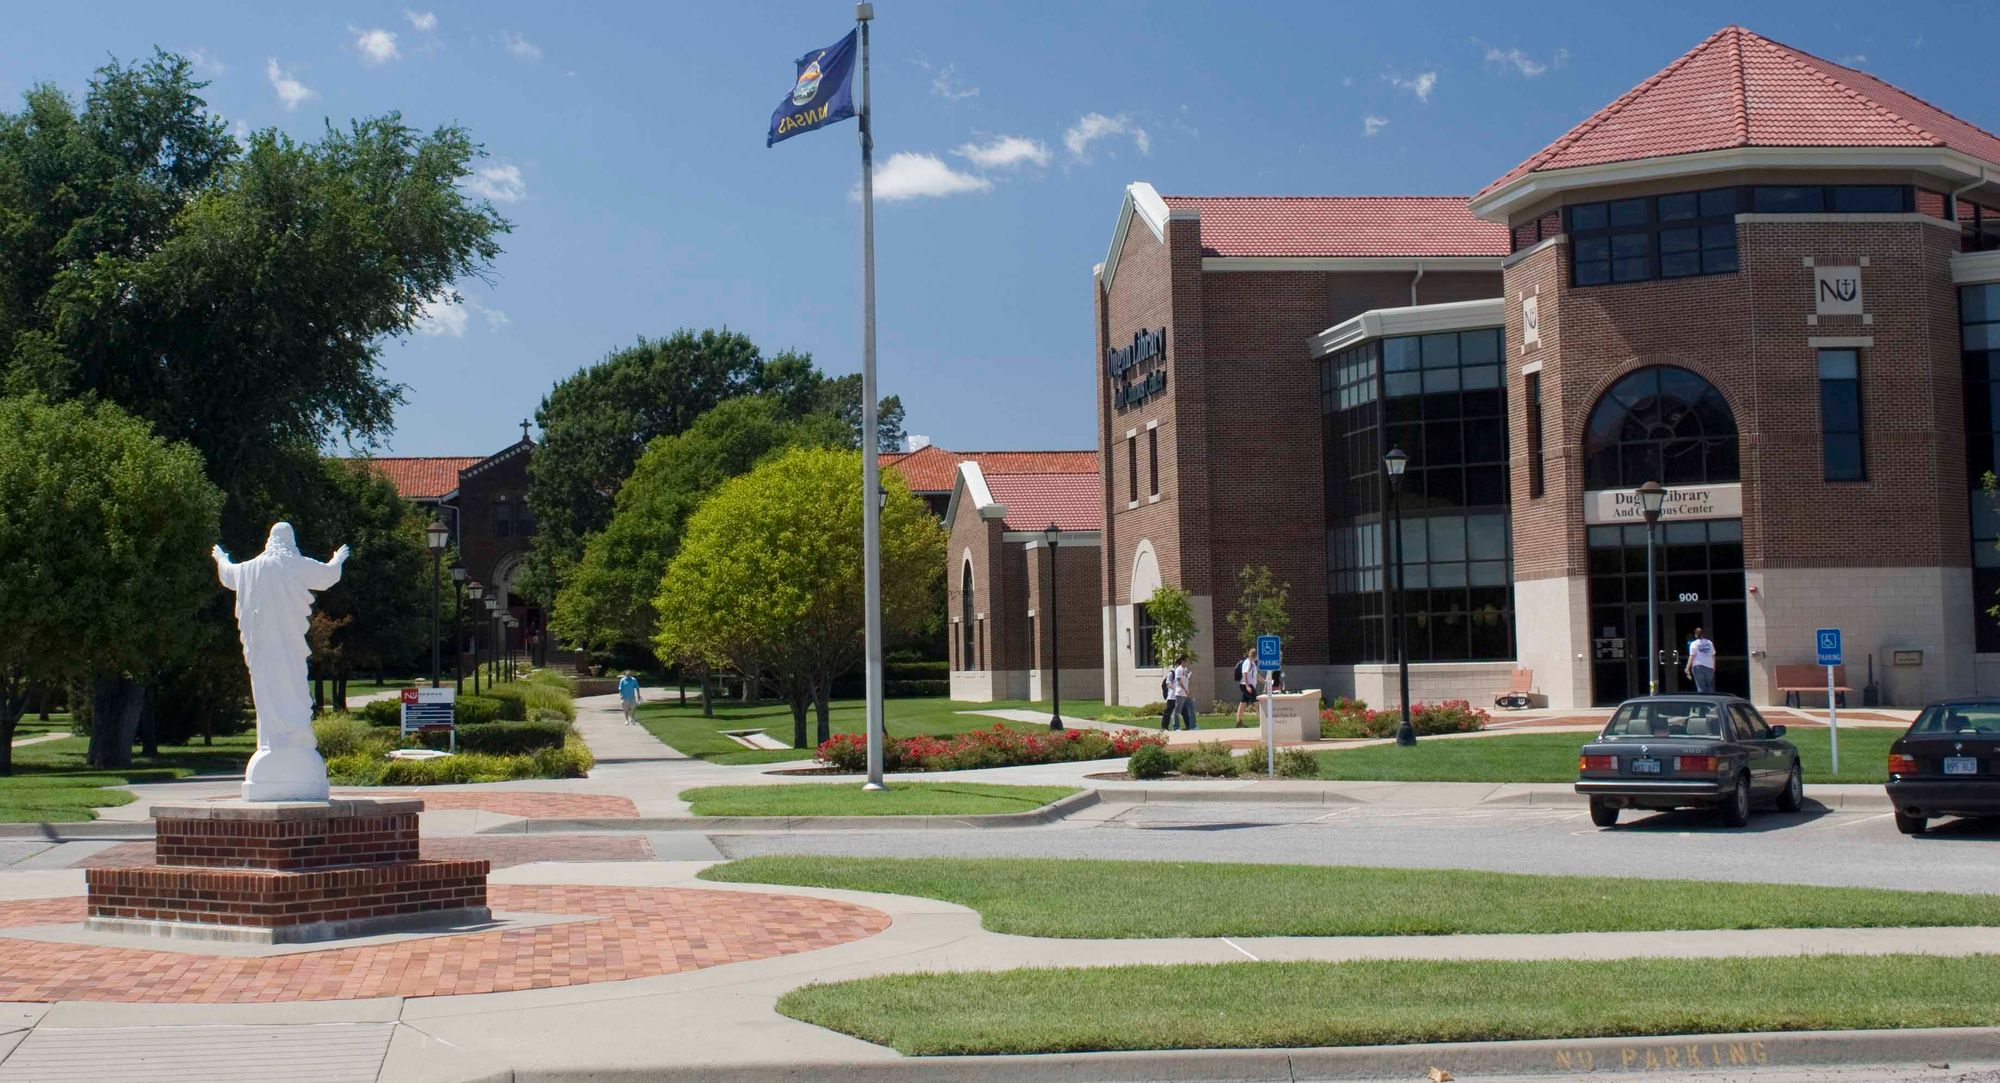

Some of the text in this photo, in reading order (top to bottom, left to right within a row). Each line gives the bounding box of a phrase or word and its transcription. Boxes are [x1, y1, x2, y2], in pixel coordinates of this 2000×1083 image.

[1615, 492, 1645, 506] Dug
[1613, 504, 1714, 518] And Cpus Center
[1679, 592, 1699, 602] 900
[1257, 659, 1280, 667] PARKING
[1818, 653, 1841, 661] PARKING
[1621, 1040, 1768, 1071] PARKING
